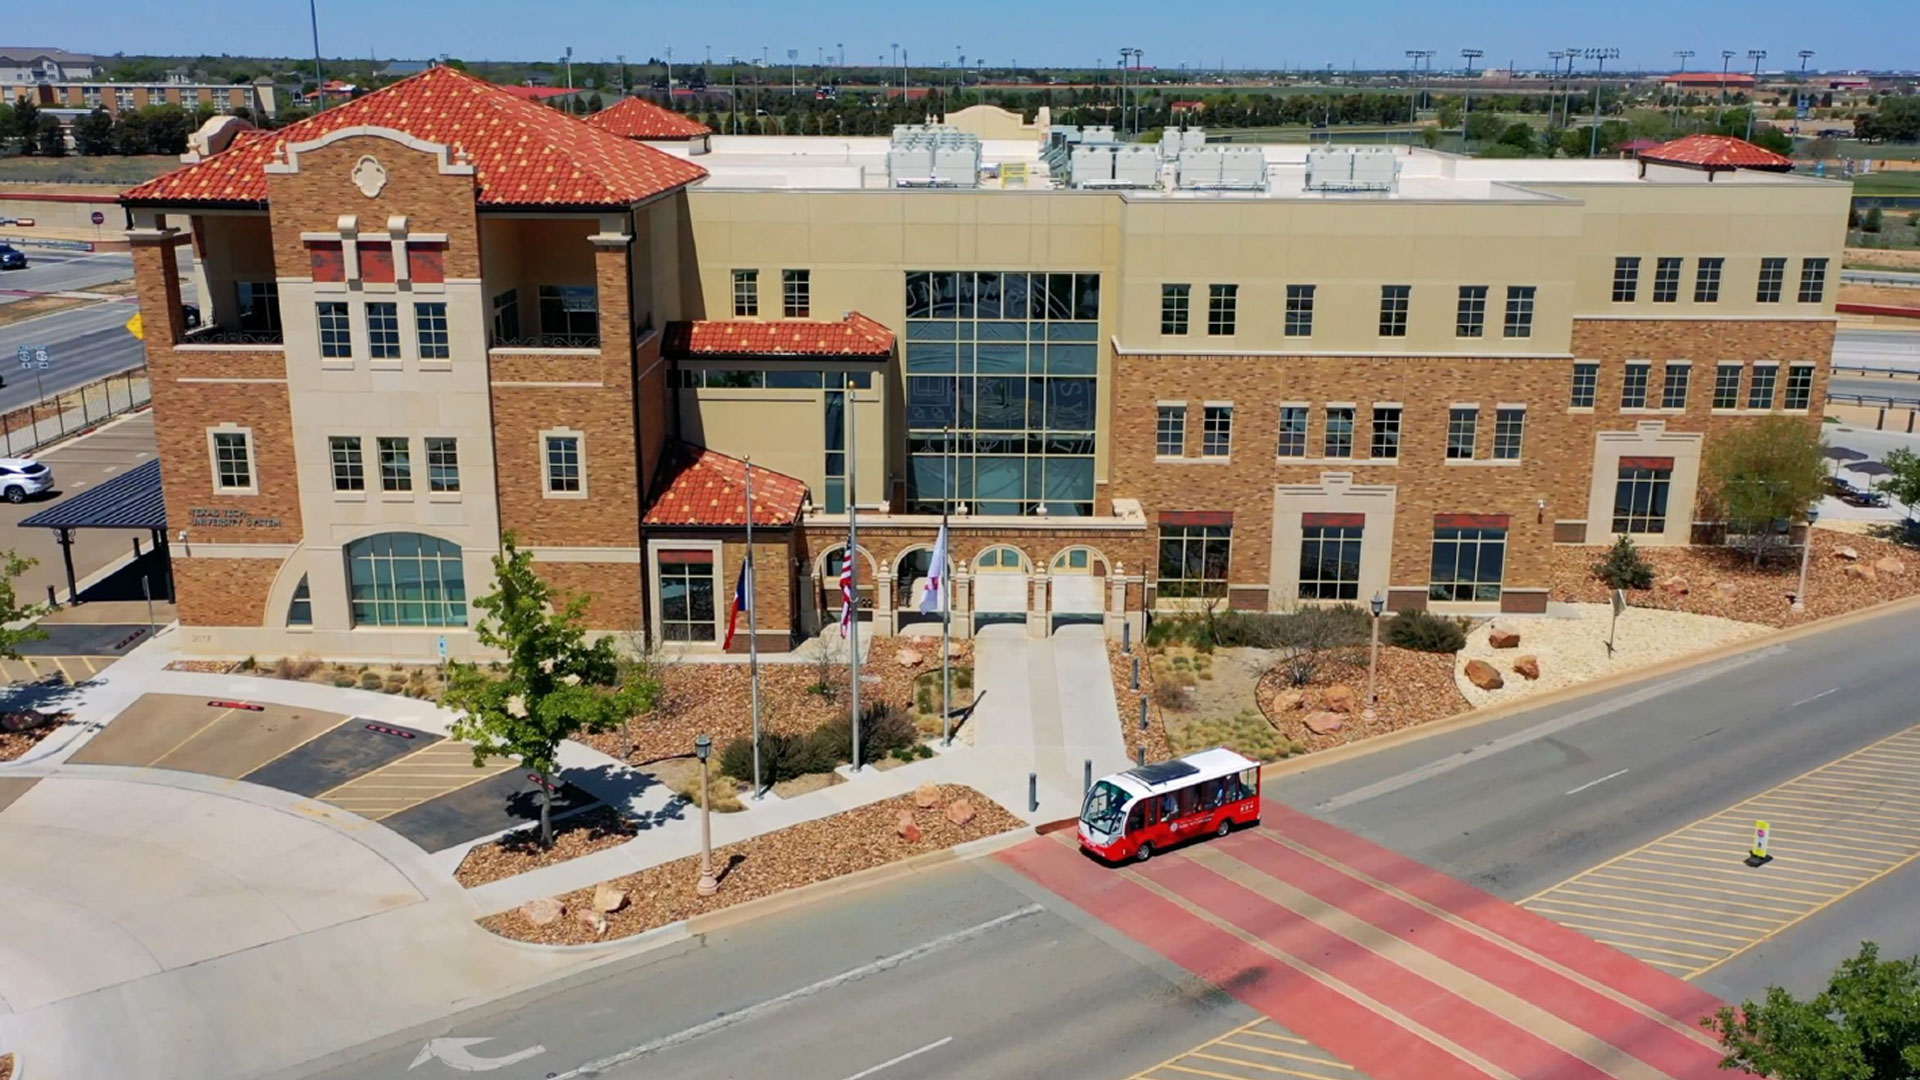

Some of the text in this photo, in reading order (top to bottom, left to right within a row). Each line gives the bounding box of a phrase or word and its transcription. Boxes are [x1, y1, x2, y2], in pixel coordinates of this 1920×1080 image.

[191, 508, 247, 518] TEXAS TECH
[191, 518, 282, 528] UNIVERSITY SYSTEM
[192, 634, 211, 643] 2017
